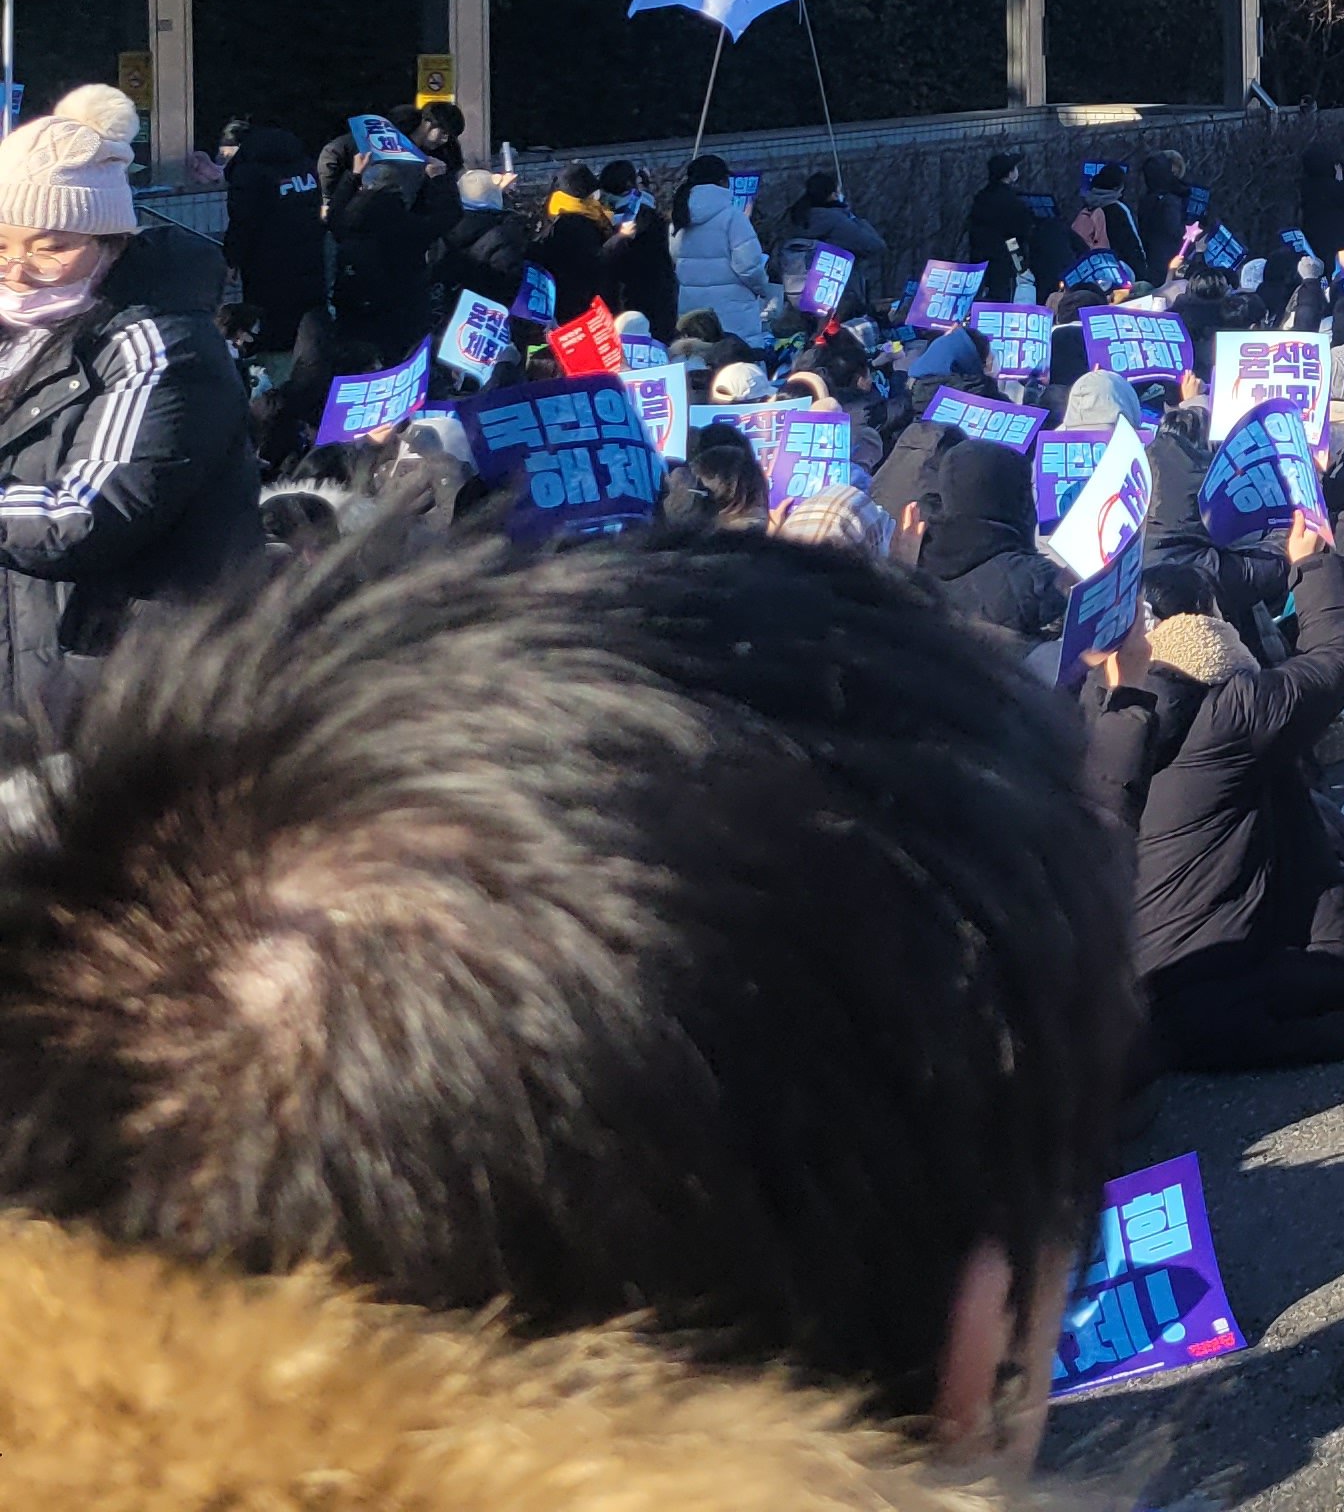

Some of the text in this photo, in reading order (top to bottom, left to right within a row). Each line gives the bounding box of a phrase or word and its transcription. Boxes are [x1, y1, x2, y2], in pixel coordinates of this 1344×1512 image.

[280, 173, 317, 195] FILA
[1089, 314, 1185, 343] 국민의힘
[336, 346, 428, 404] 국민의힘
[1108, 341, 1183, 372] 해체!
[1239, 341, 1321, 381] 윤석열
[479, 388, 645, 451] 국민의
[930, 397, 1038, 445] 국민의힘
[525, 443, 662, 508] 해체
[1042, 443, 1107, 477] 국민
